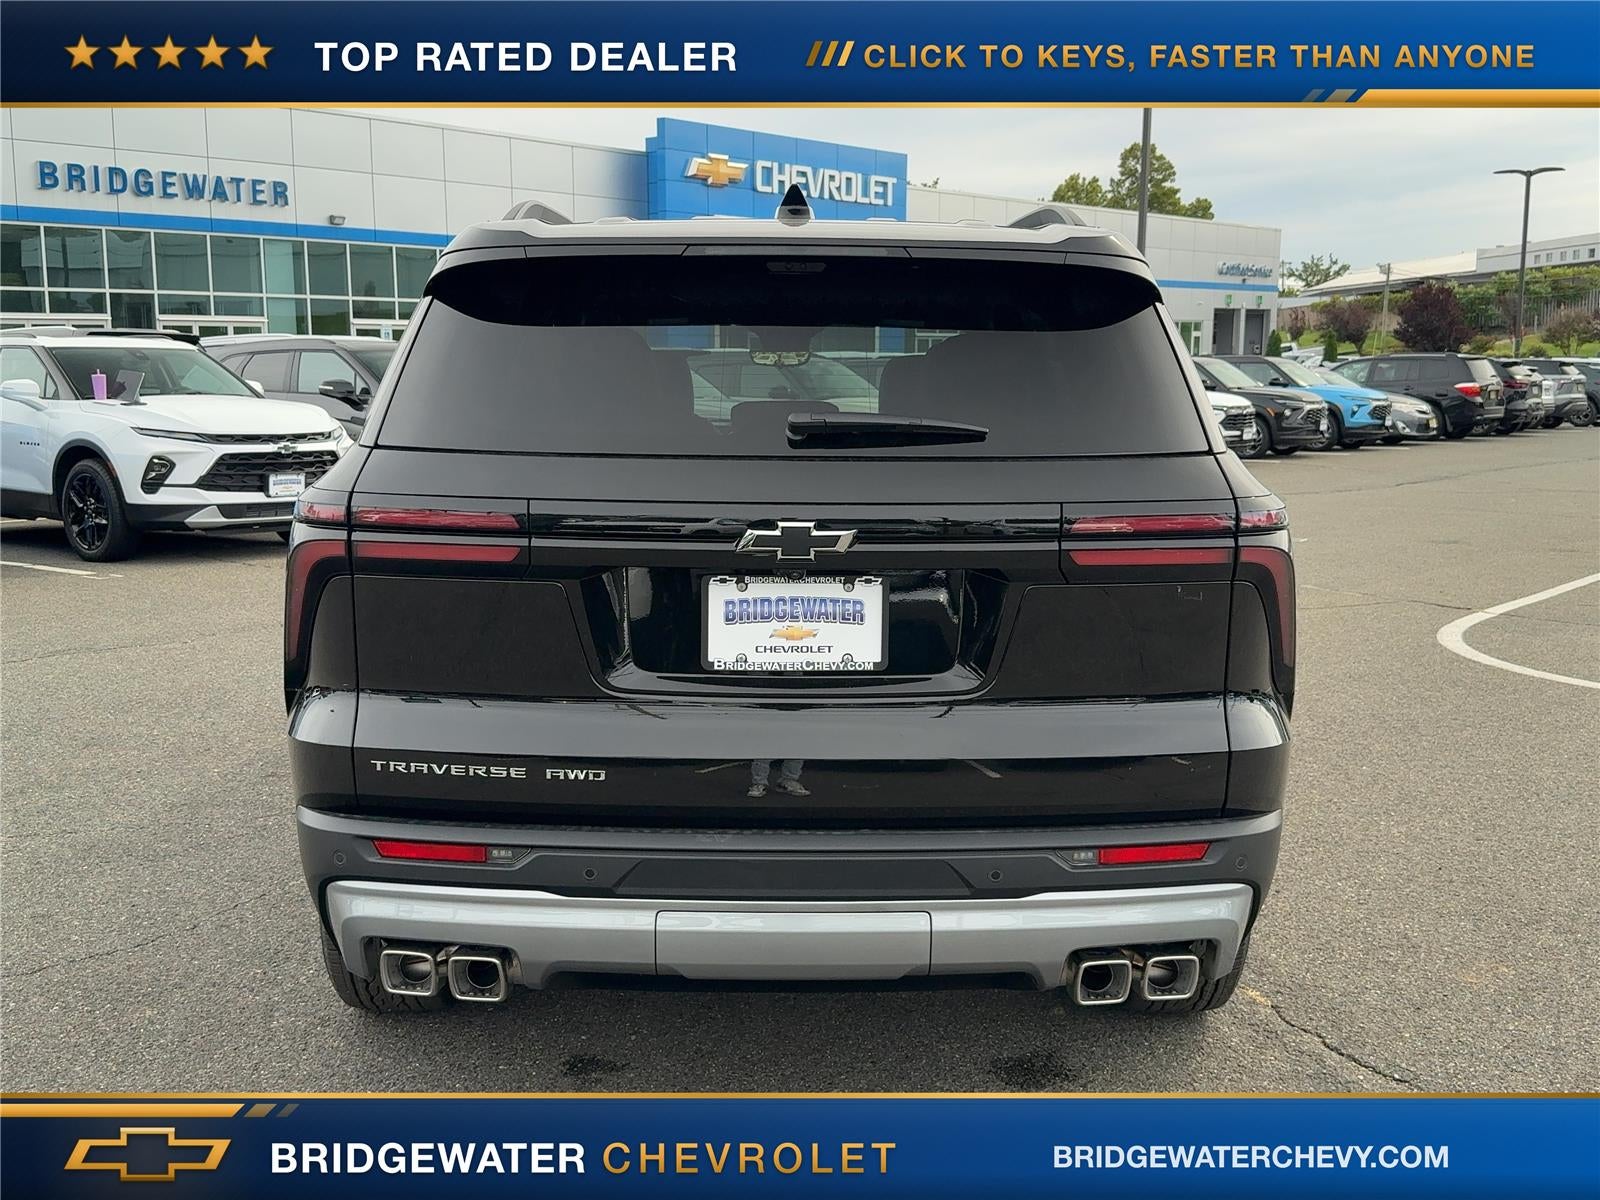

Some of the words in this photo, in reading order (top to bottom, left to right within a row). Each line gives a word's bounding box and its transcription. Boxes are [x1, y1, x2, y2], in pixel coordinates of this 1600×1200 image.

[36, 160, 289, 207] BRIDGEWATER
[755, 160, 897, 206] CHEVROLET
[723, 595, 866, 625] BRIDGEWATER
[755, 645, 834, 654] CHEVROLET
[370, 760, 527, 779] TRAVERSE
[545, 769, 607, 781] AWD
